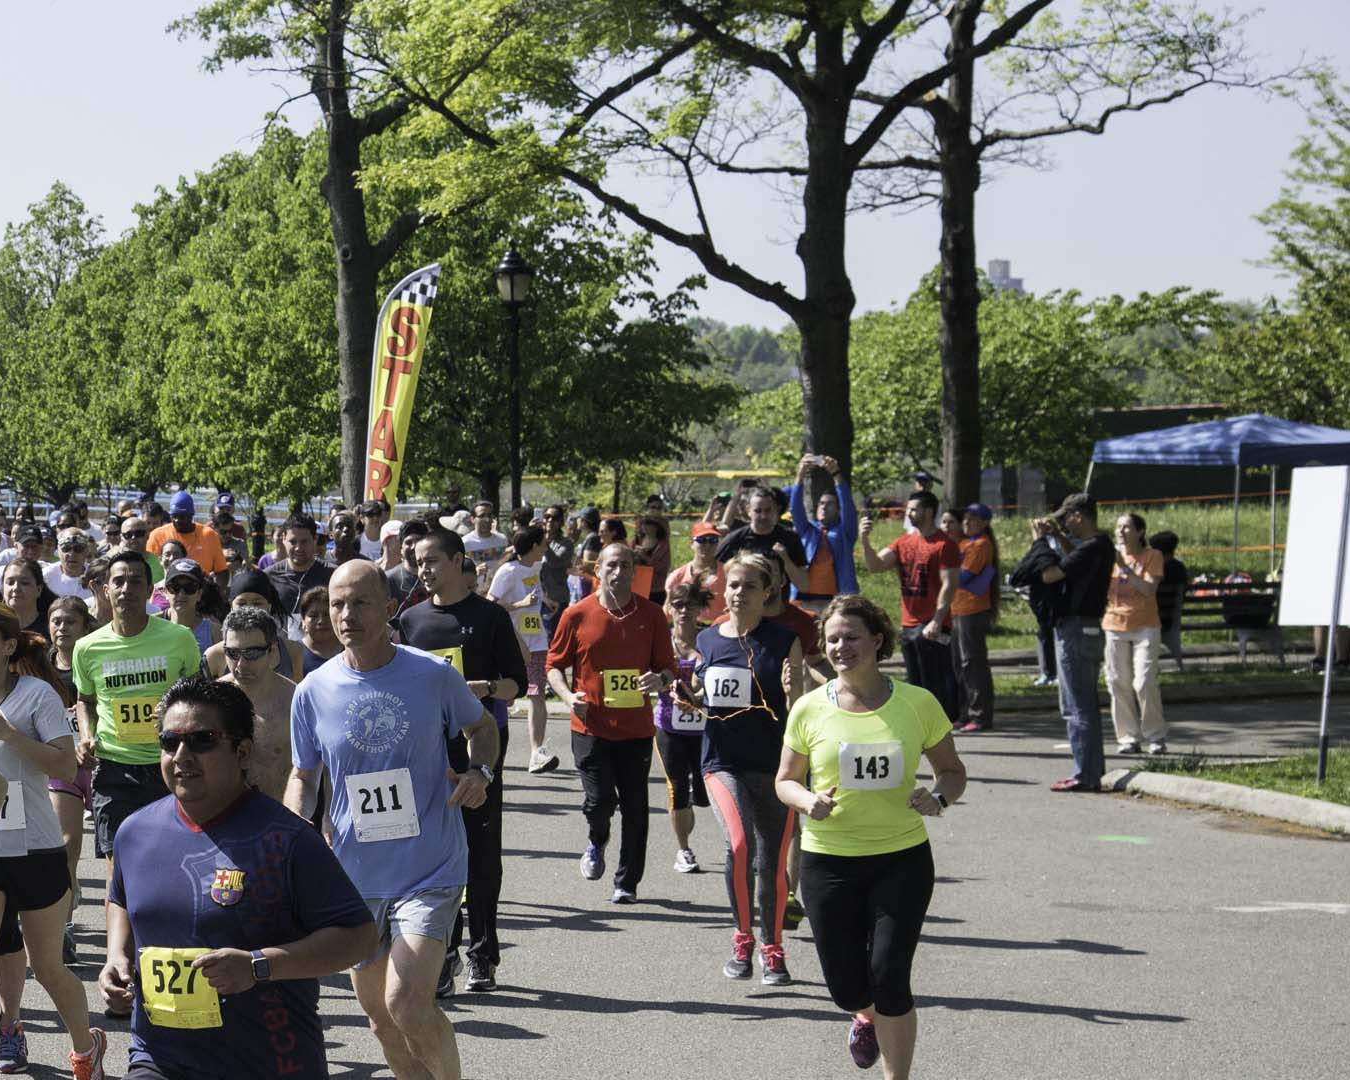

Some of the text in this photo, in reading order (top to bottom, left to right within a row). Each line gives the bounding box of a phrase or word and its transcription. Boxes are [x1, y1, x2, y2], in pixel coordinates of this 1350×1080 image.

[365, 306, 420, 503] STAR
[104, 669, 168, 689] NUTRITION
[712, 678, 739, 698] 162
[120, 703, 153, 724] 519
[345, 721, 410, 753] MARATHON TEAM
[853, 755, 890, 780] 143
[358, 783, 403, 815] 211
[152, 959, 198, 995] 527
